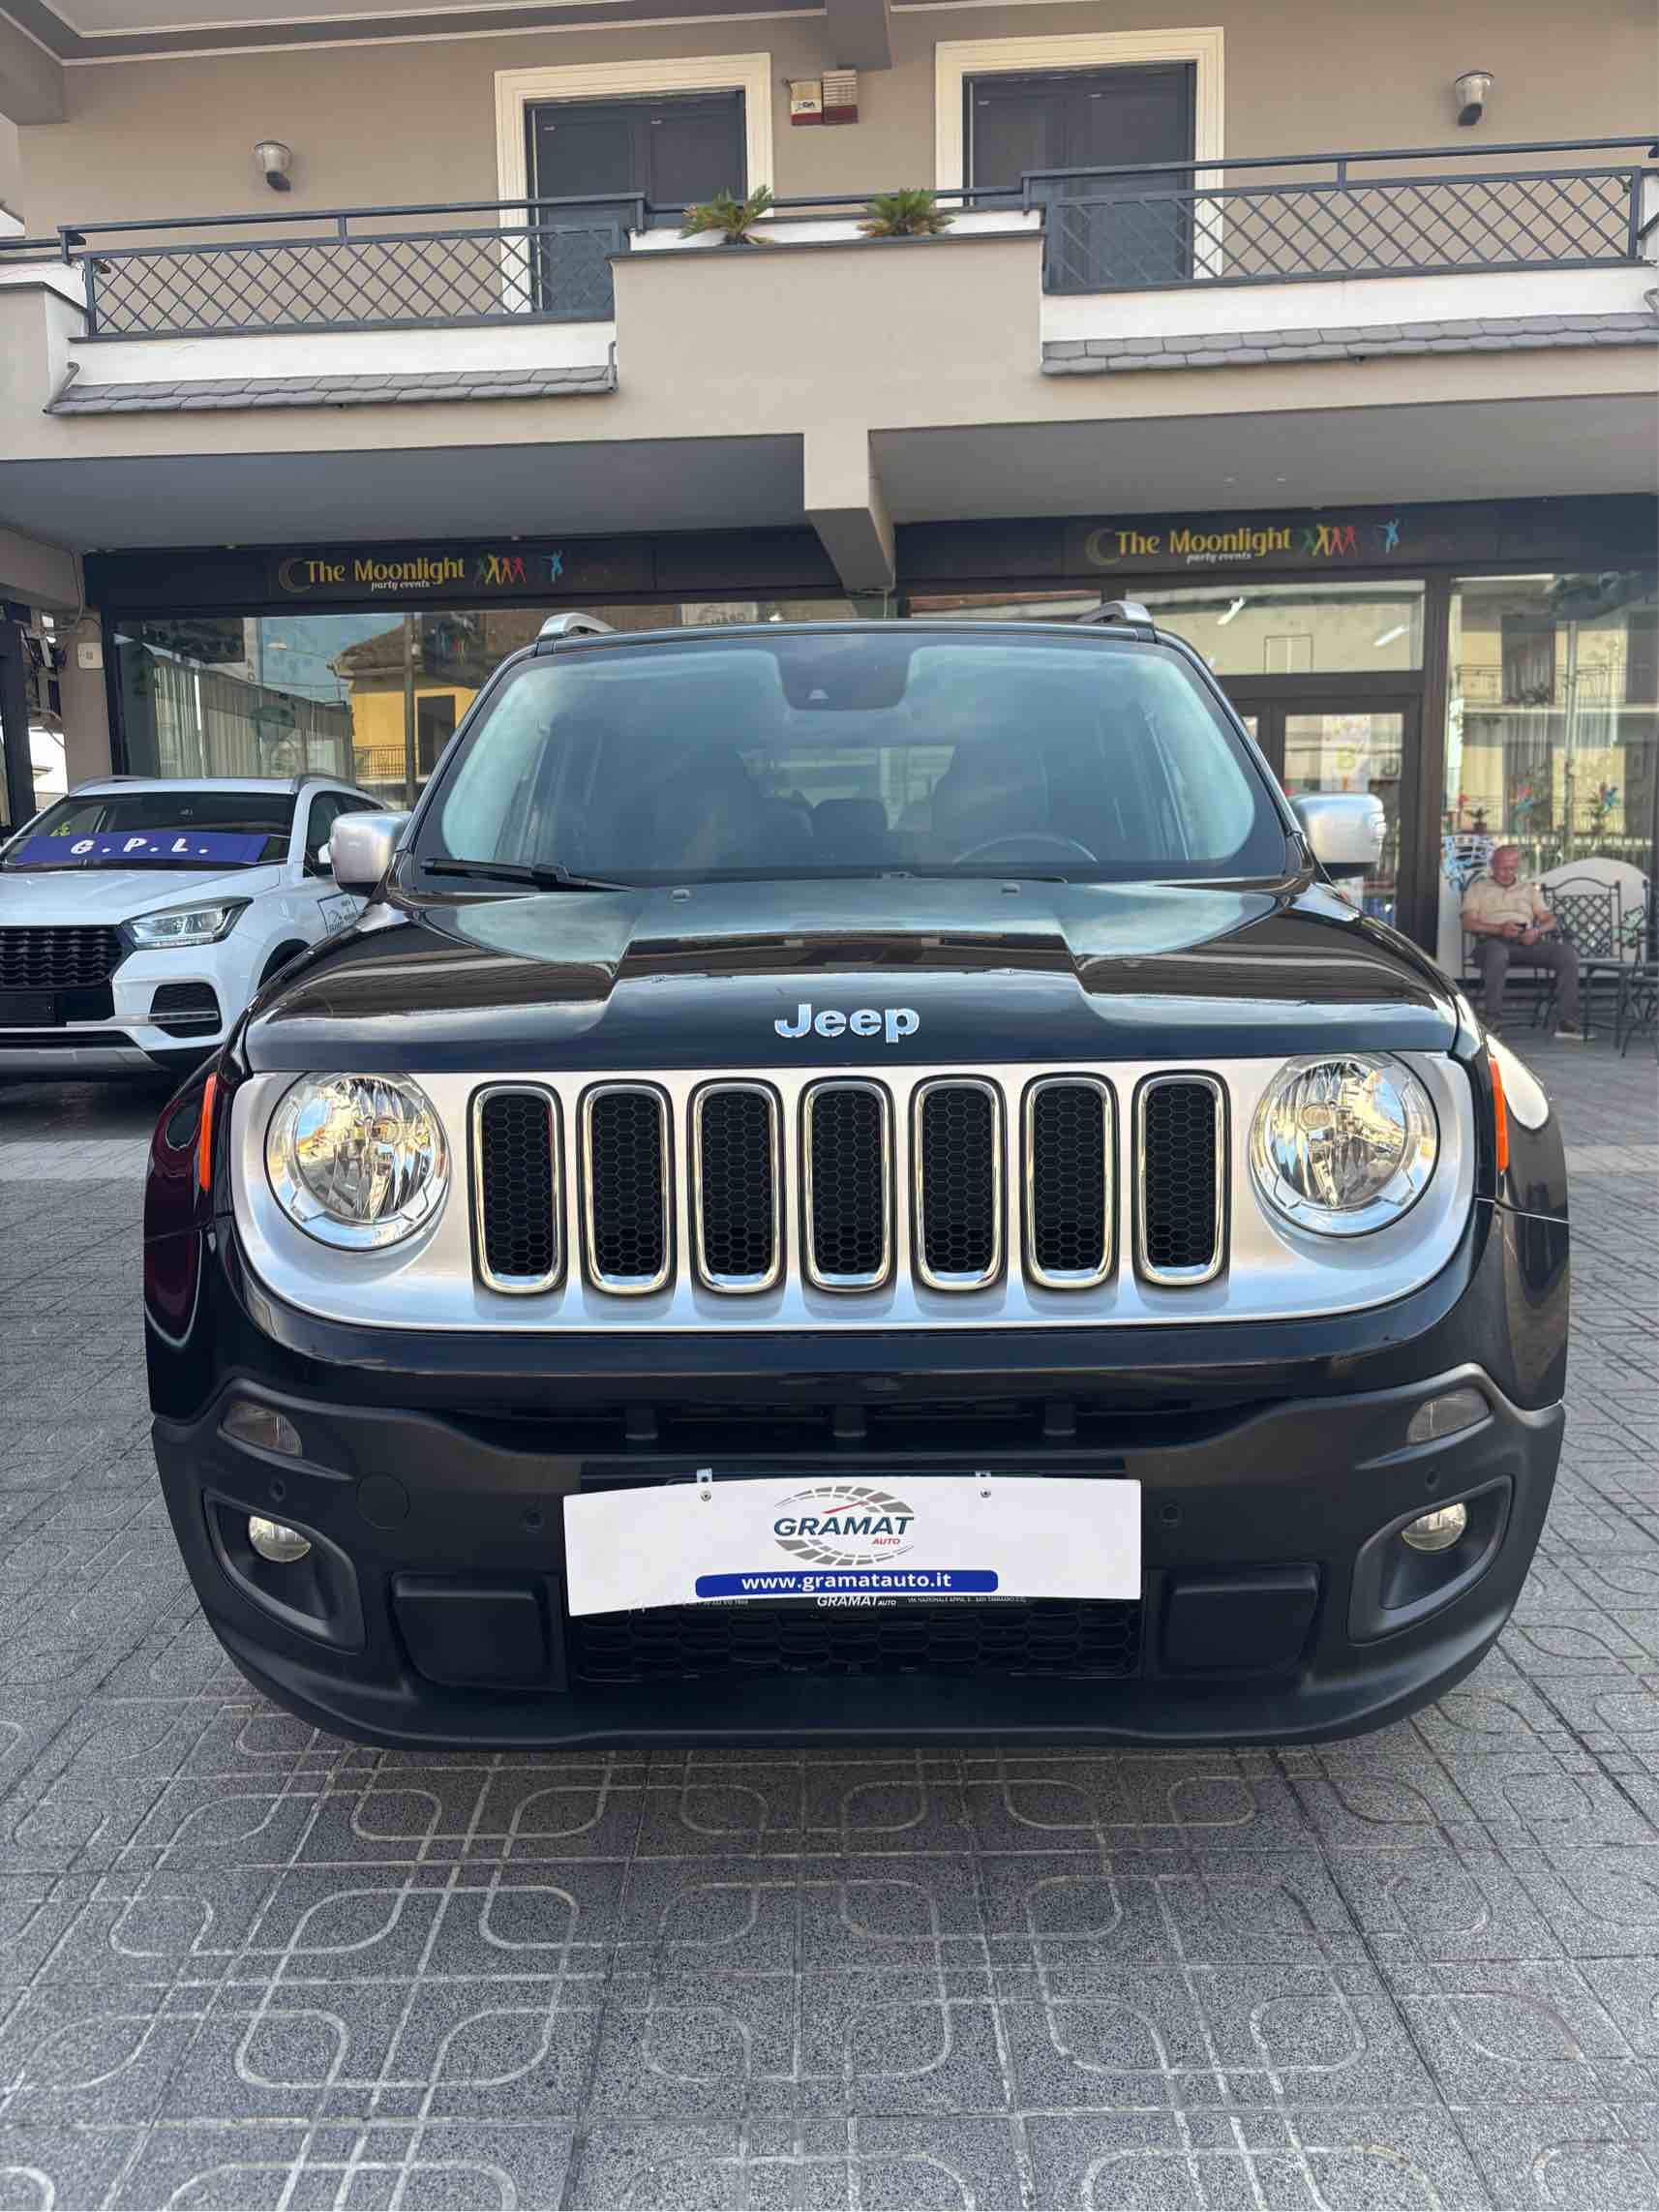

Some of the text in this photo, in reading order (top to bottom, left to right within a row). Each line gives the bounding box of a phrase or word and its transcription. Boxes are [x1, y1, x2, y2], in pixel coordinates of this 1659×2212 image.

[1116, 527, 1292, 558] The Moonlight
[1186, 551, 1252, 564] party events
[307, 557, 466, 585] The Moonlight
[371, 580, 431, 591] party events
[774, 1003, 920, 1044] Jeep
[773, 1516, 915, 1536] GRAMAT
[871, 1537, 901, 1546] AUTO
[741, 1571, 952, 1592] www.gramatauto.it
[817, 1596, 878, 1607] GRAMAT
